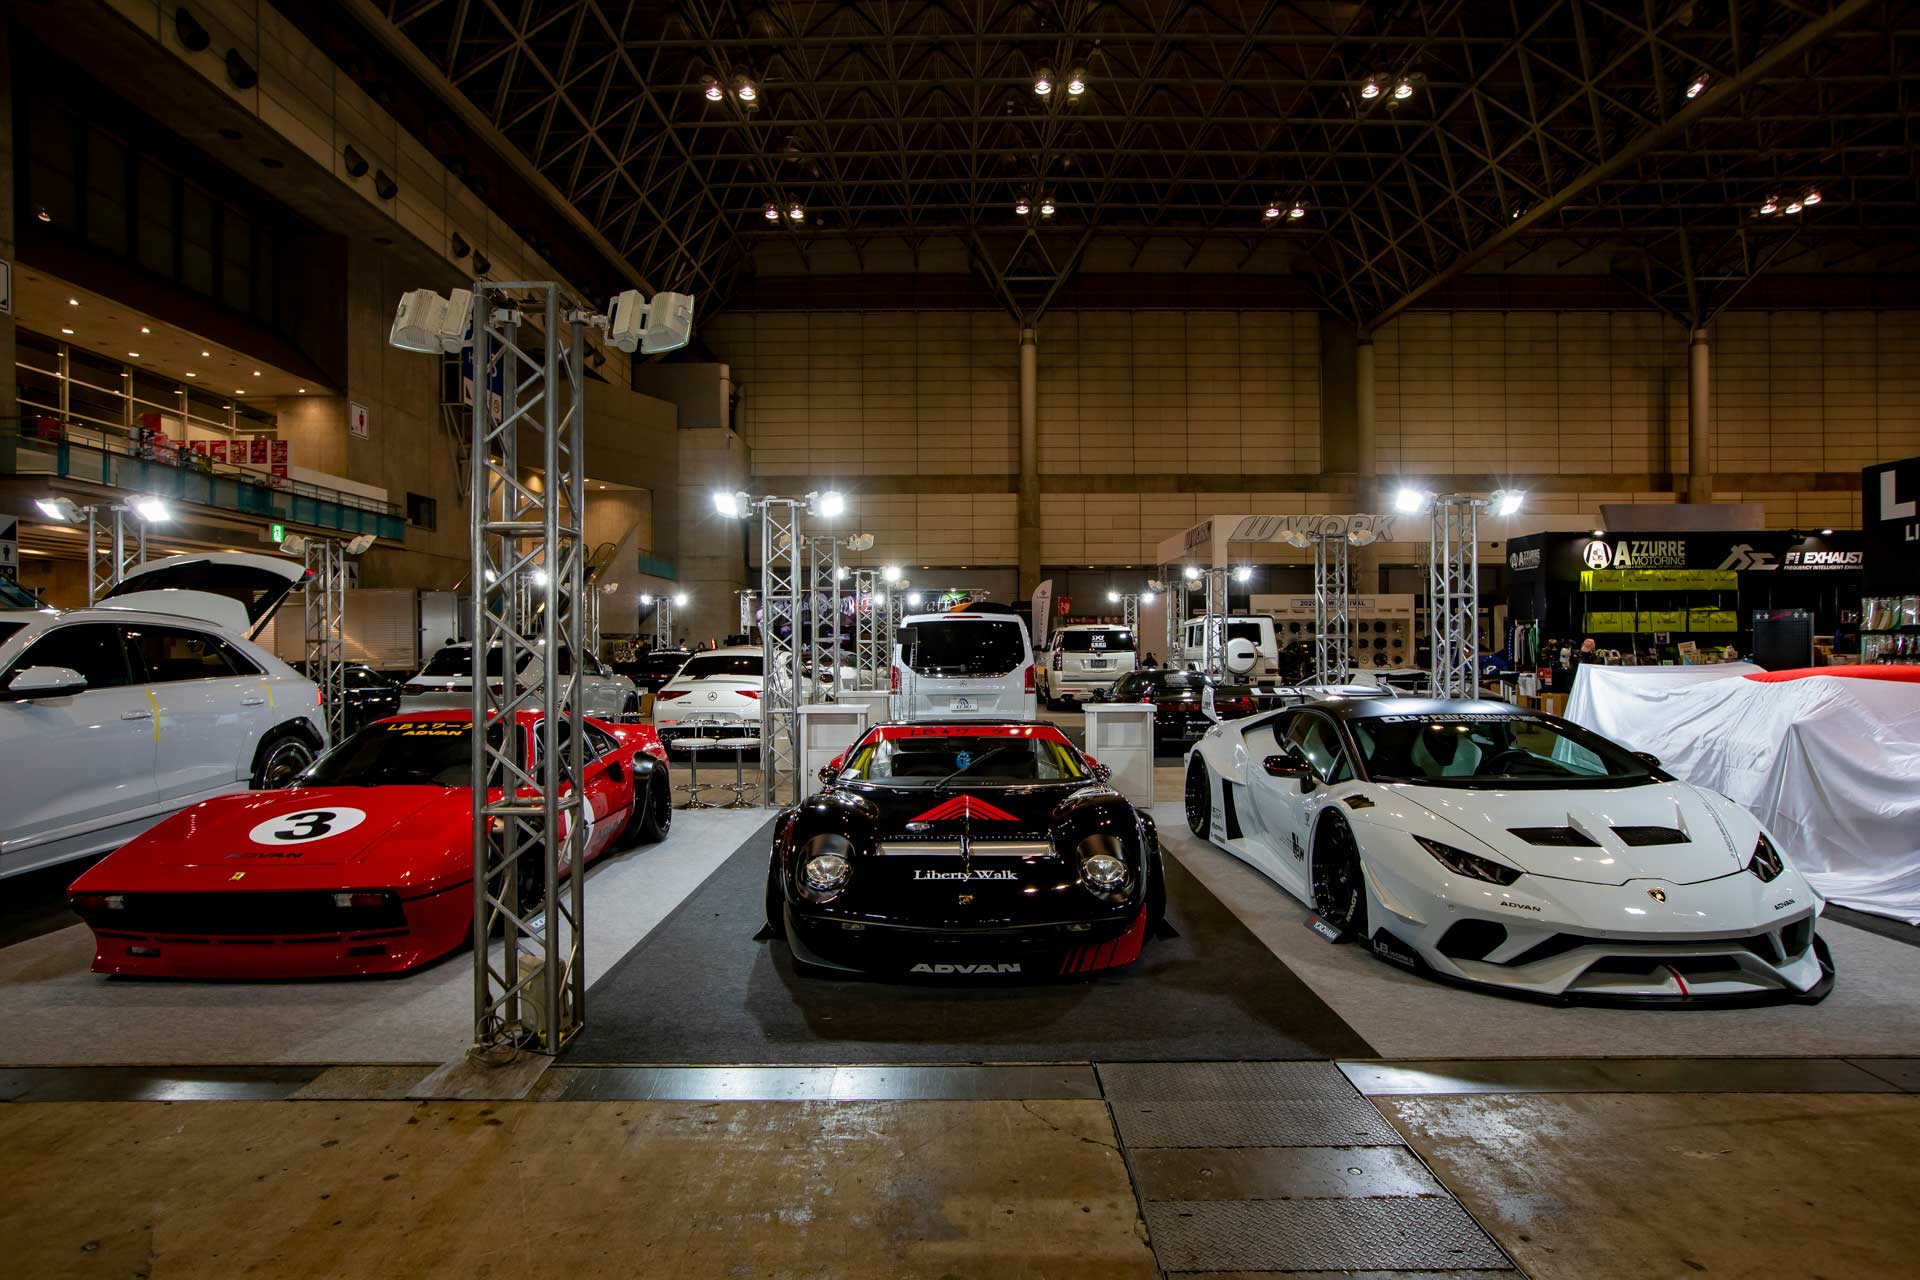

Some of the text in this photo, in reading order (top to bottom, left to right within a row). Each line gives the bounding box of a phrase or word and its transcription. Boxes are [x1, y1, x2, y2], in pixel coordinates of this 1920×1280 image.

[1613, 540, 1686, 566] AZZURRE
[1631, 556, 1686, 566] MOTORING
[274, 811, 337, 840] 3
[914, 870, 1019, 882] Liberty Walk
[1500, 901, 1541, 911] ADVAN
[1774, 899, 1796, 910] ADVAN
[910, 963, 1021, 973] ADVAN
